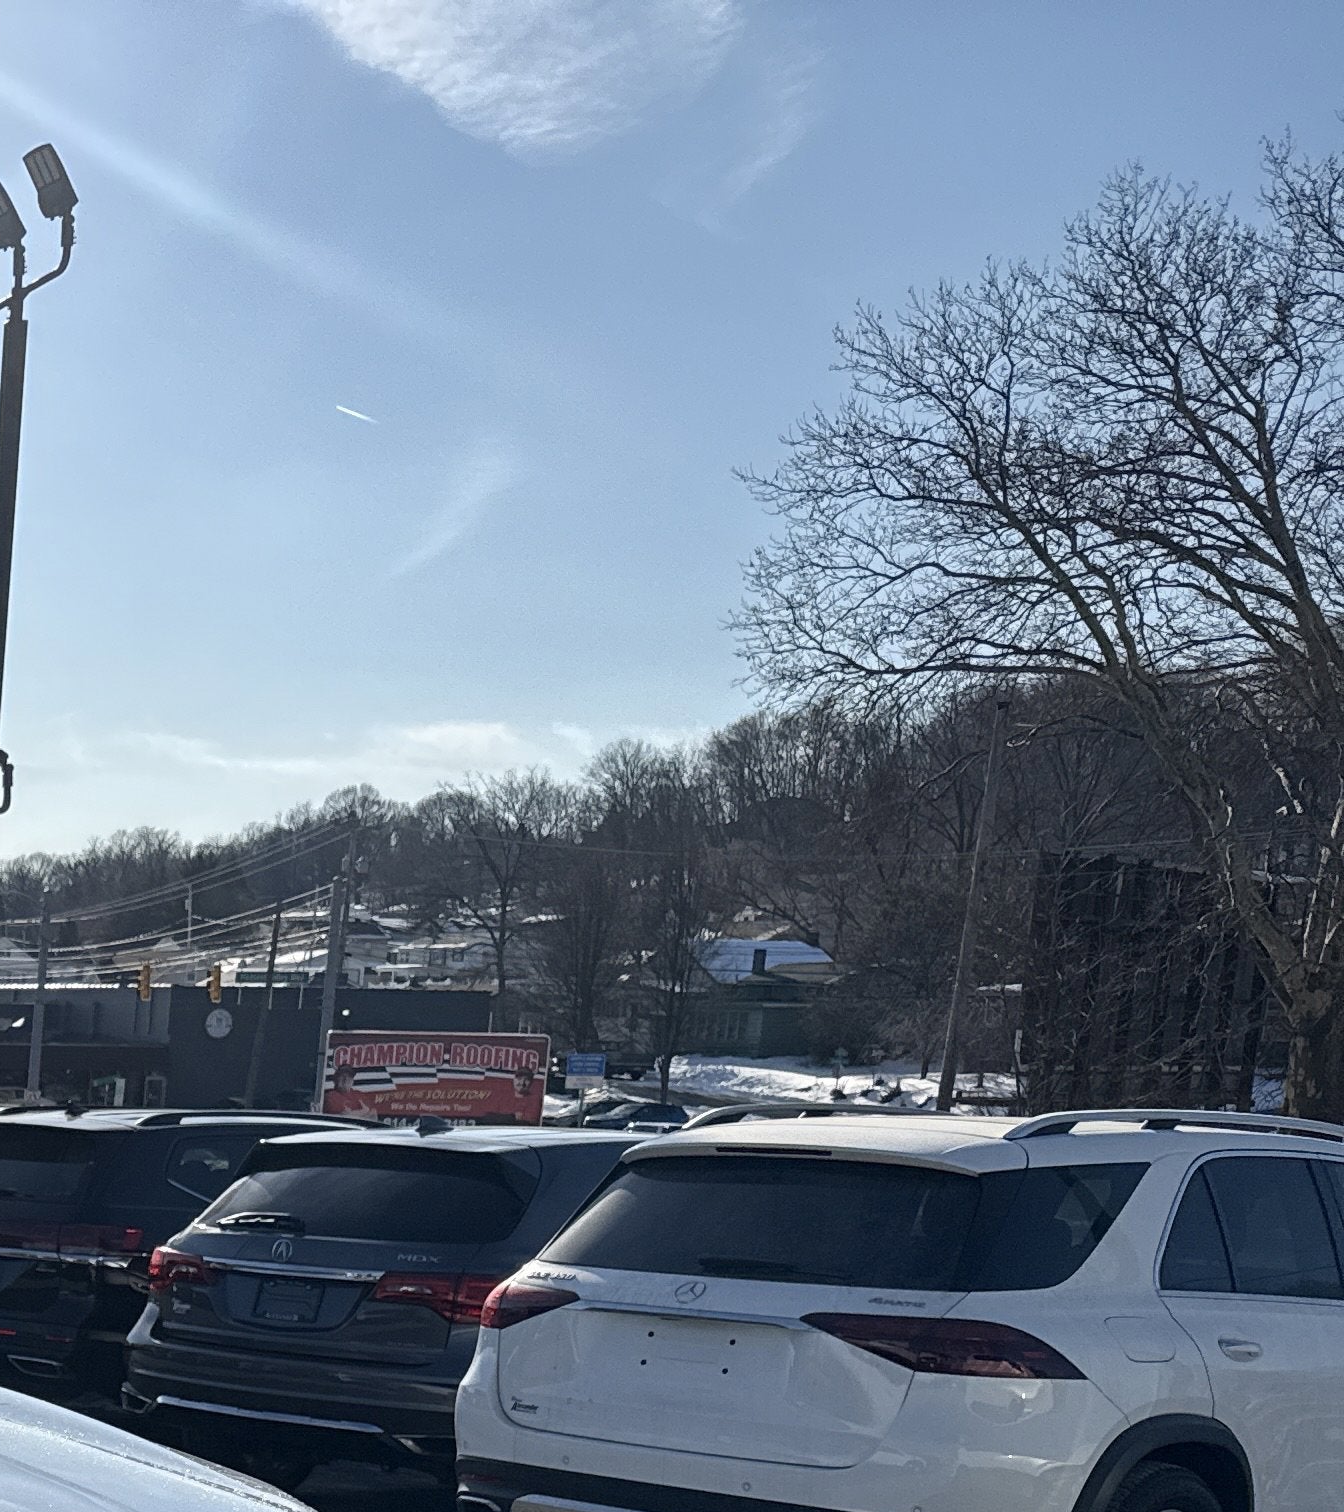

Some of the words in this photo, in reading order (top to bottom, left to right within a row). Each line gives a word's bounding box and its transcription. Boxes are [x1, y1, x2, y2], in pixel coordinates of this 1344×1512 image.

[334, 1042, 445, 1068] CHAMPION
[450, 1043, 540, 1073] ROOFING
[397, 1253, 440, 1264] MDX
